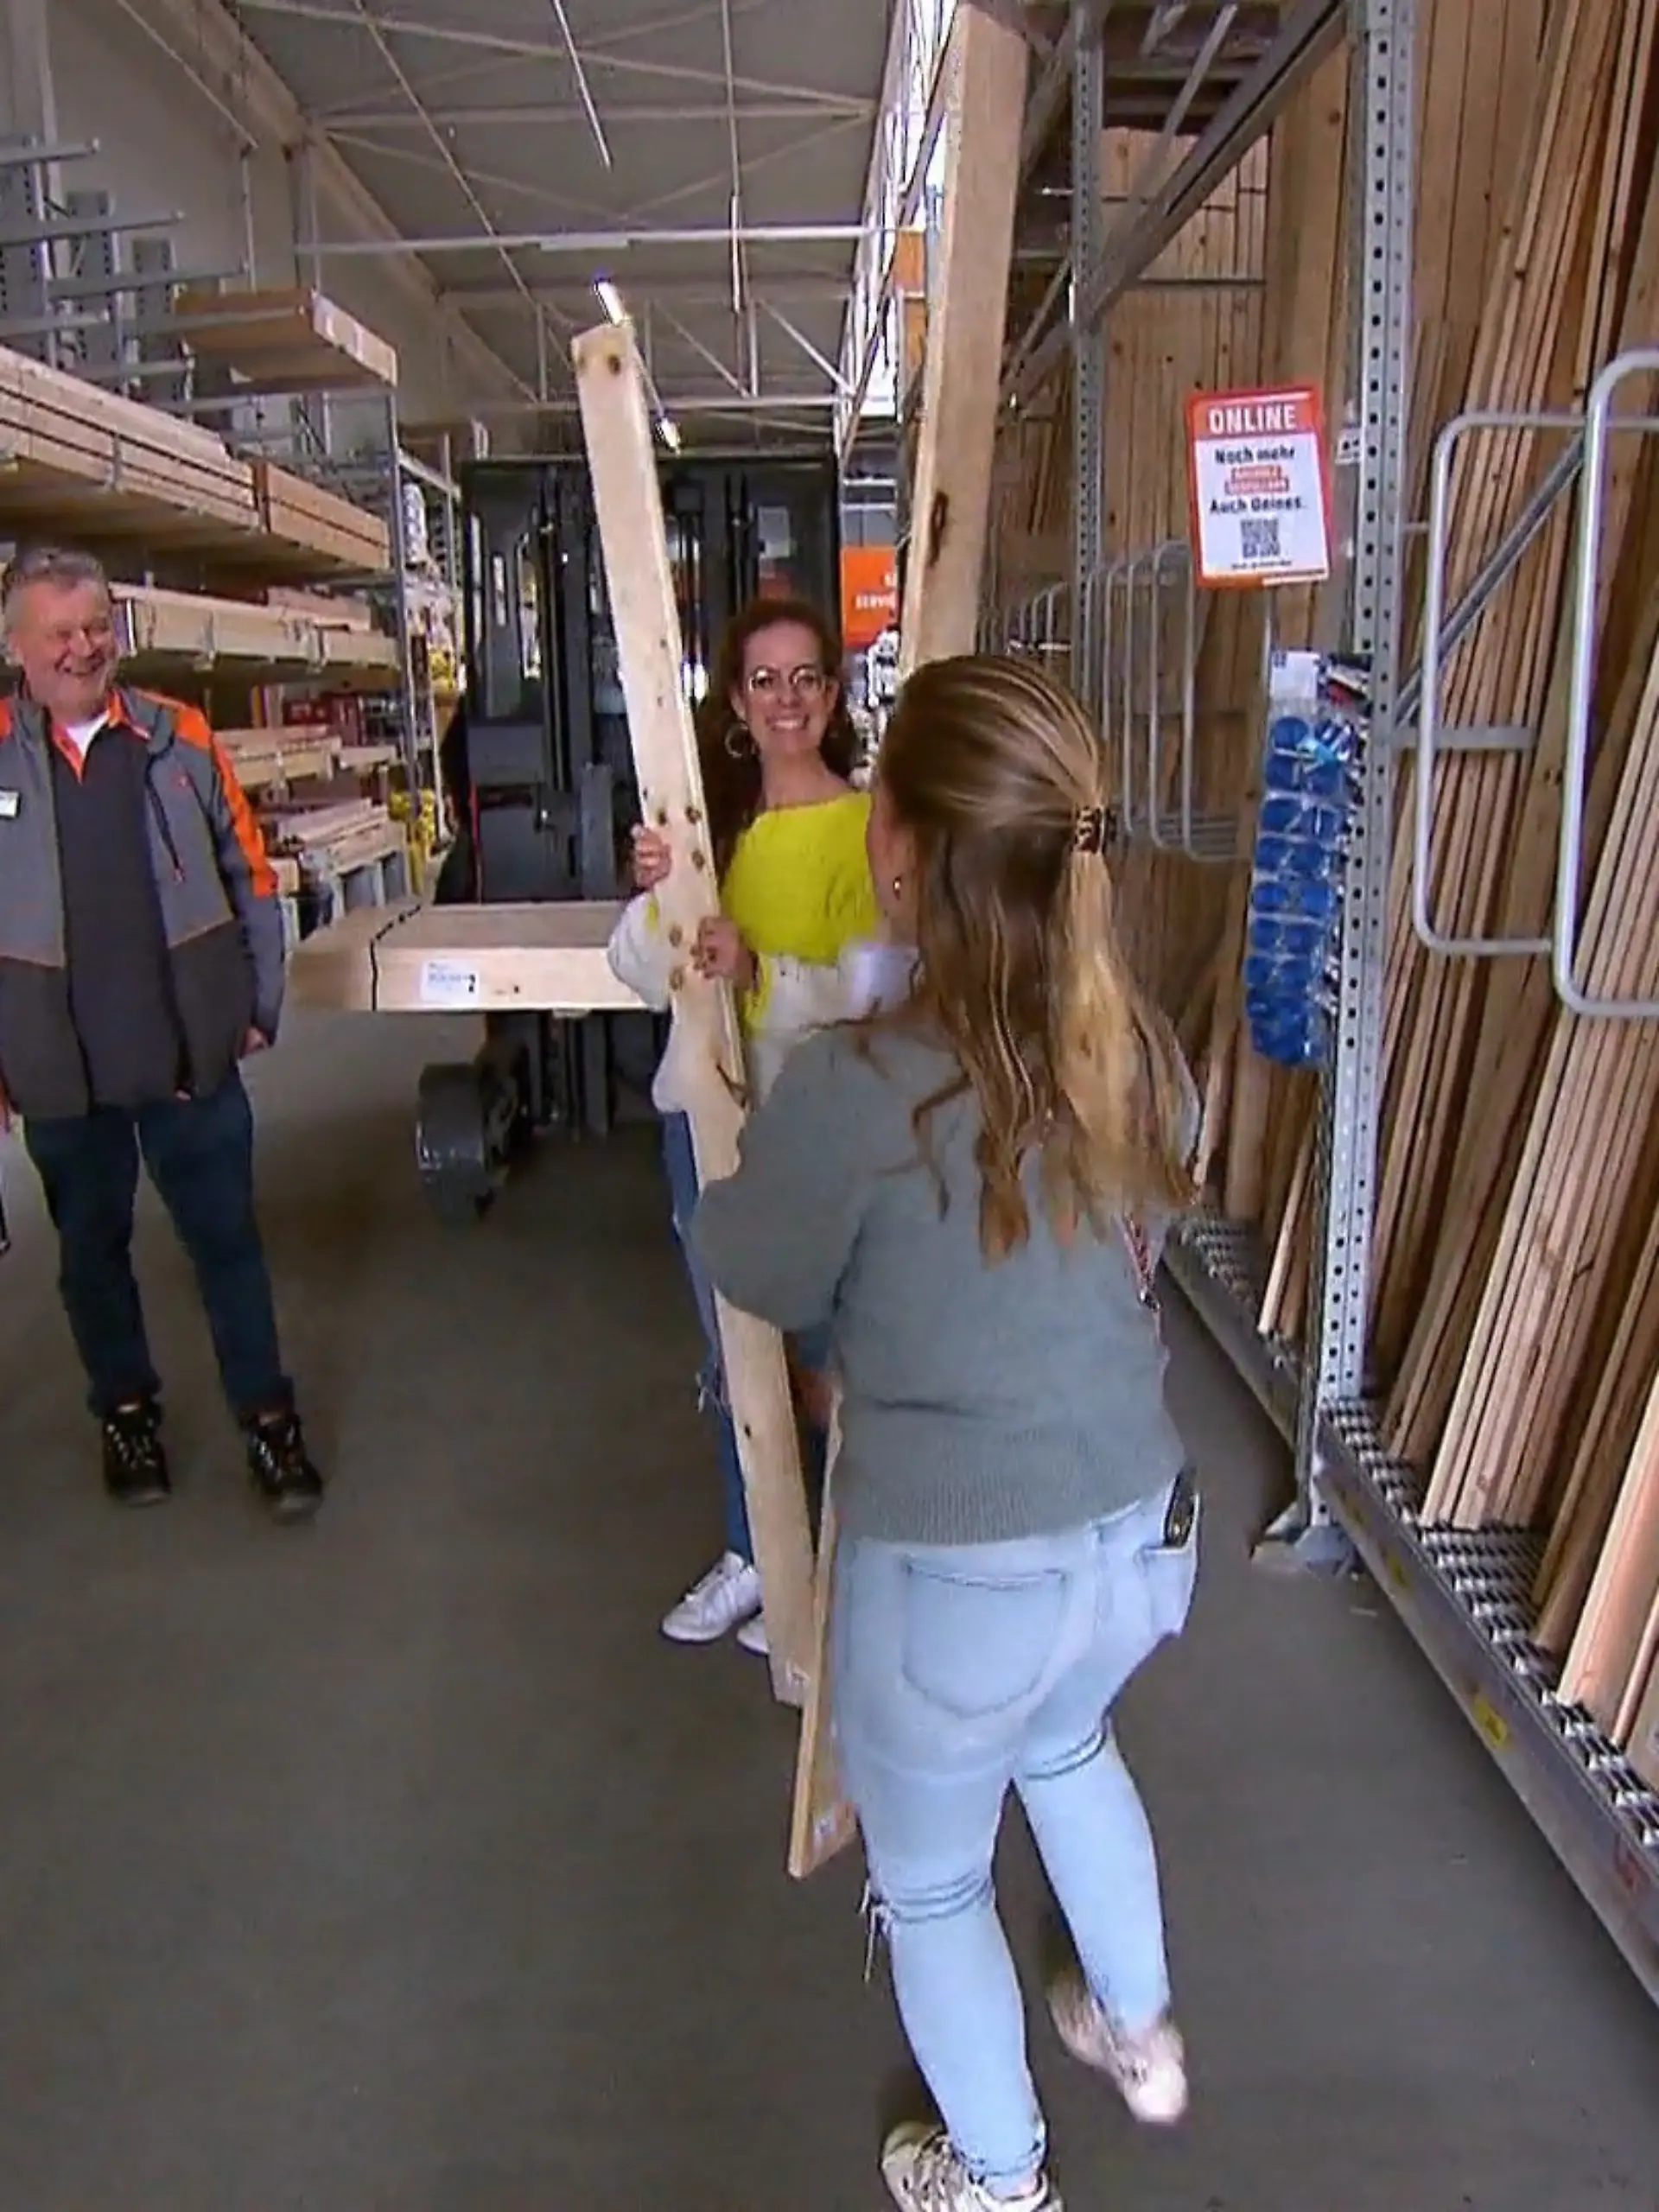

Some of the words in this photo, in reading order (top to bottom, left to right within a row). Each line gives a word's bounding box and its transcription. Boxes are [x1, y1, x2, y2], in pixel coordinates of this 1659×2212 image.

[1209, 404, 1297, 434] ONLINE
[1215, 446, 1254, 464] Noch
[1210, 499, 1247, 514] Auch
